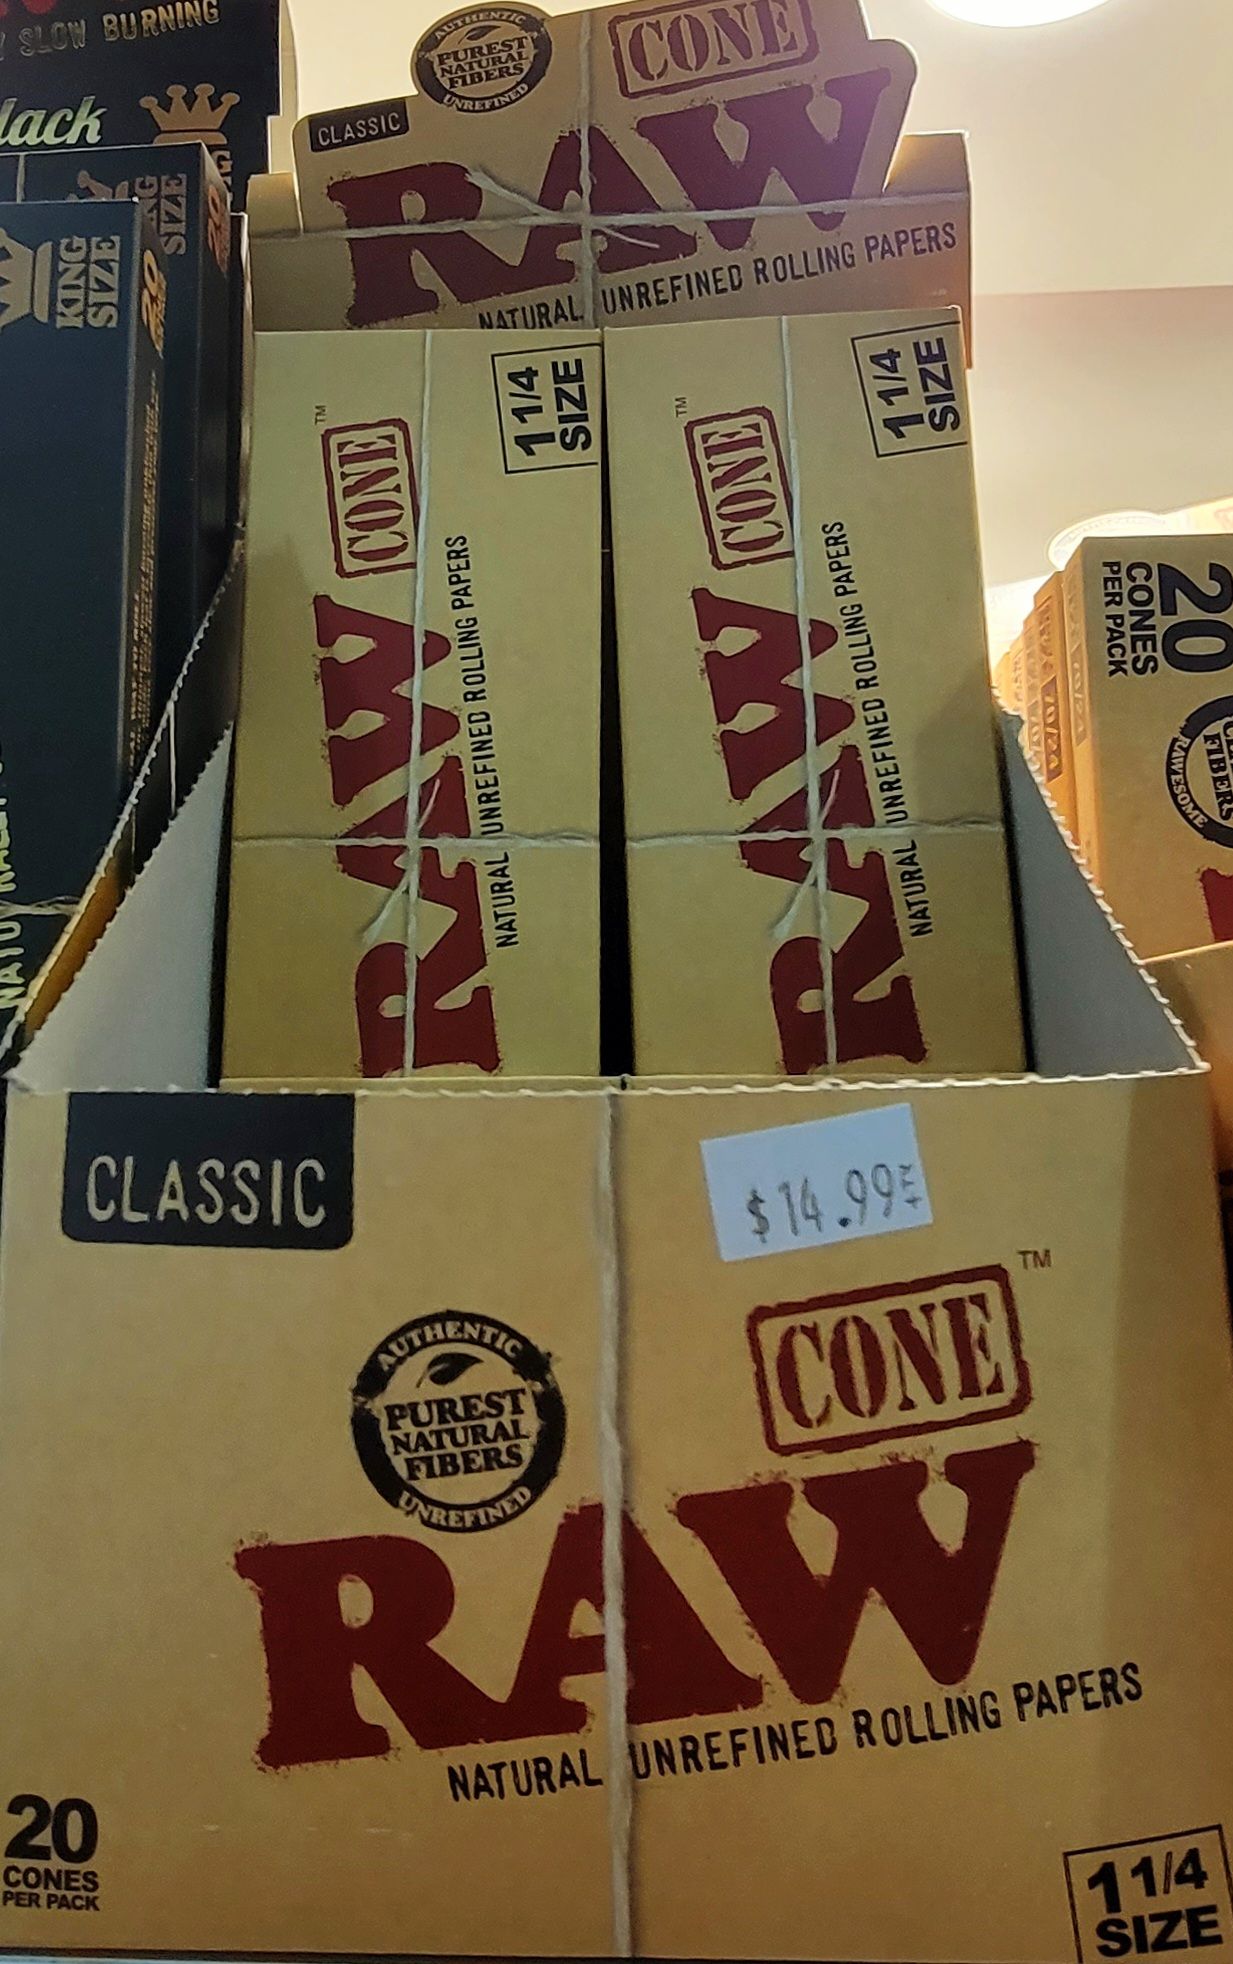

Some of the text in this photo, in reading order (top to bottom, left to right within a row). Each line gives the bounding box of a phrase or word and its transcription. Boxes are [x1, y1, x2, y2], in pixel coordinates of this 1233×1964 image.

[19, 19, 86, 56] SLOW
[102, 0, 220, 41] BURNING
[434, 10, 527, 40] AUTHENTIC
[436, 36, 528, 66] PUREST
[440, 51, 530, 78] NATURAL
[628, 0, 798, 81] CONE
[443, 83, 529, 112] UNREFINED
[448, 63, 525, 89] FIBERS
[317, 111, 401, 147] CLASSIC
[160, 173, 187, 255] SIZE
[326, 67, 892, 329] RAW
[56, 236, 87, 329] KING
[87, 235, 120, 329] SIZE
[478, 222, 956, 330] NATURAL UNREFINED ROLLING PAPERS
[315, 404, 327, 425] TM
[507, 366, 555, 457] 1 1/4
[551, 358, 592, 452] SIZE
[675, 396, 687, 418] TM
[869, 348, 924, 439] 1 1/4
[912, 337, 961, 432] SIZE
[336, 434, 409, 562] CONE
[701, 422, 785, 553] CONE
[1101, 561, 1129, 678] PER PACK
[1125, 561, 1158, 676] CONES
[1156, 561, 1233, 674] 20
[445, 535, 519, 948] NATURAL UNREFINED ROLLING PAPERS
[821, 521, 933, 938] NATURAL UNREFINED ROLLING PAPERS
[1169, 737, 1208, 828] RAWESOME
[312, 594, 500, 1078] RAW
[688, 586, 930, 1075] RAW
[86, 1155, 326, 1228] CLASSIC
[746, 1163, 894, 1243] $14.99
[1017, 1249, 1051, 1270] TM
[377, 1321, 523, 1371] AUTHENTIC
[775, 1292, 1005, 1430] CONE
[384, 1388, 526, 1431] PUREST
[390, 1418, 531, 1455] NATURAL
[404, 1443, 523, 1481] FIBERS
[398, 1485, 532, 1529] UNREFINED
[232, 1438, 1037, 1771] RAW
[447, 1661, 1144, 1802] NATURAL UNREFINED ROLLING PAPERS
[4, 1793, 98, 1863] 20
[2, 1890, 100, 1912] PER PACK
[3, 1865, 99, 1893] CONES
[1087, 1847, 1208, 1914] 1 1/4
[1095, 1904, 1224, 1958] SIZE
